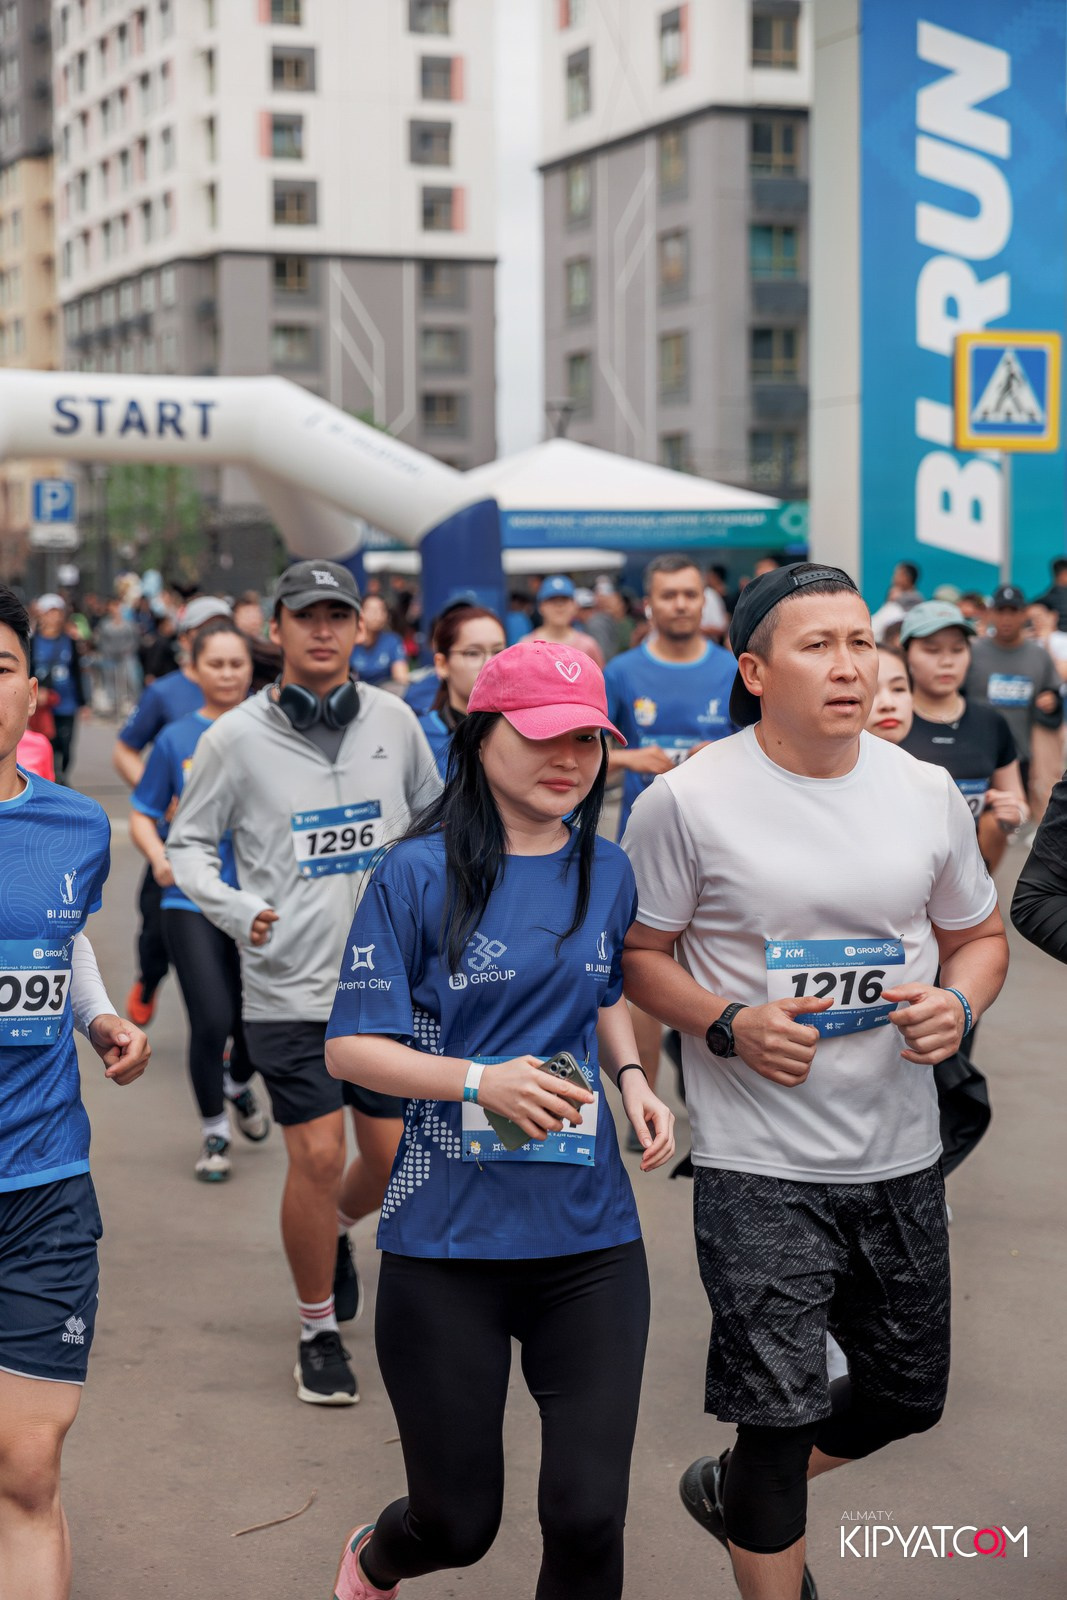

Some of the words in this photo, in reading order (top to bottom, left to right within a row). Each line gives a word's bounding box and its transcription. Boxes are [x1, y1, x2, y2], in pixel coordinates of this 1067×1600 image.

[915, 18, 1011, 358] RUN
[52, 395, 217, 440] START
[42, 481, 70, 520] P
[306, 824, 374, 856] 1296
[47, 910, 56, 918] BI
[586, 963, 594, 972] BI
[771, 946, 782, 958] 5
[785, 949, 804, 958] KM
[0, 974, 66, 1012] 093
[338, 981, 365, 990] Arena
[368, 978, 392, 991] City
[451, 975, 466, 988] BI
[470, 970, 516, 984] GROUP
[792, 970, 886, 1006] 1216
